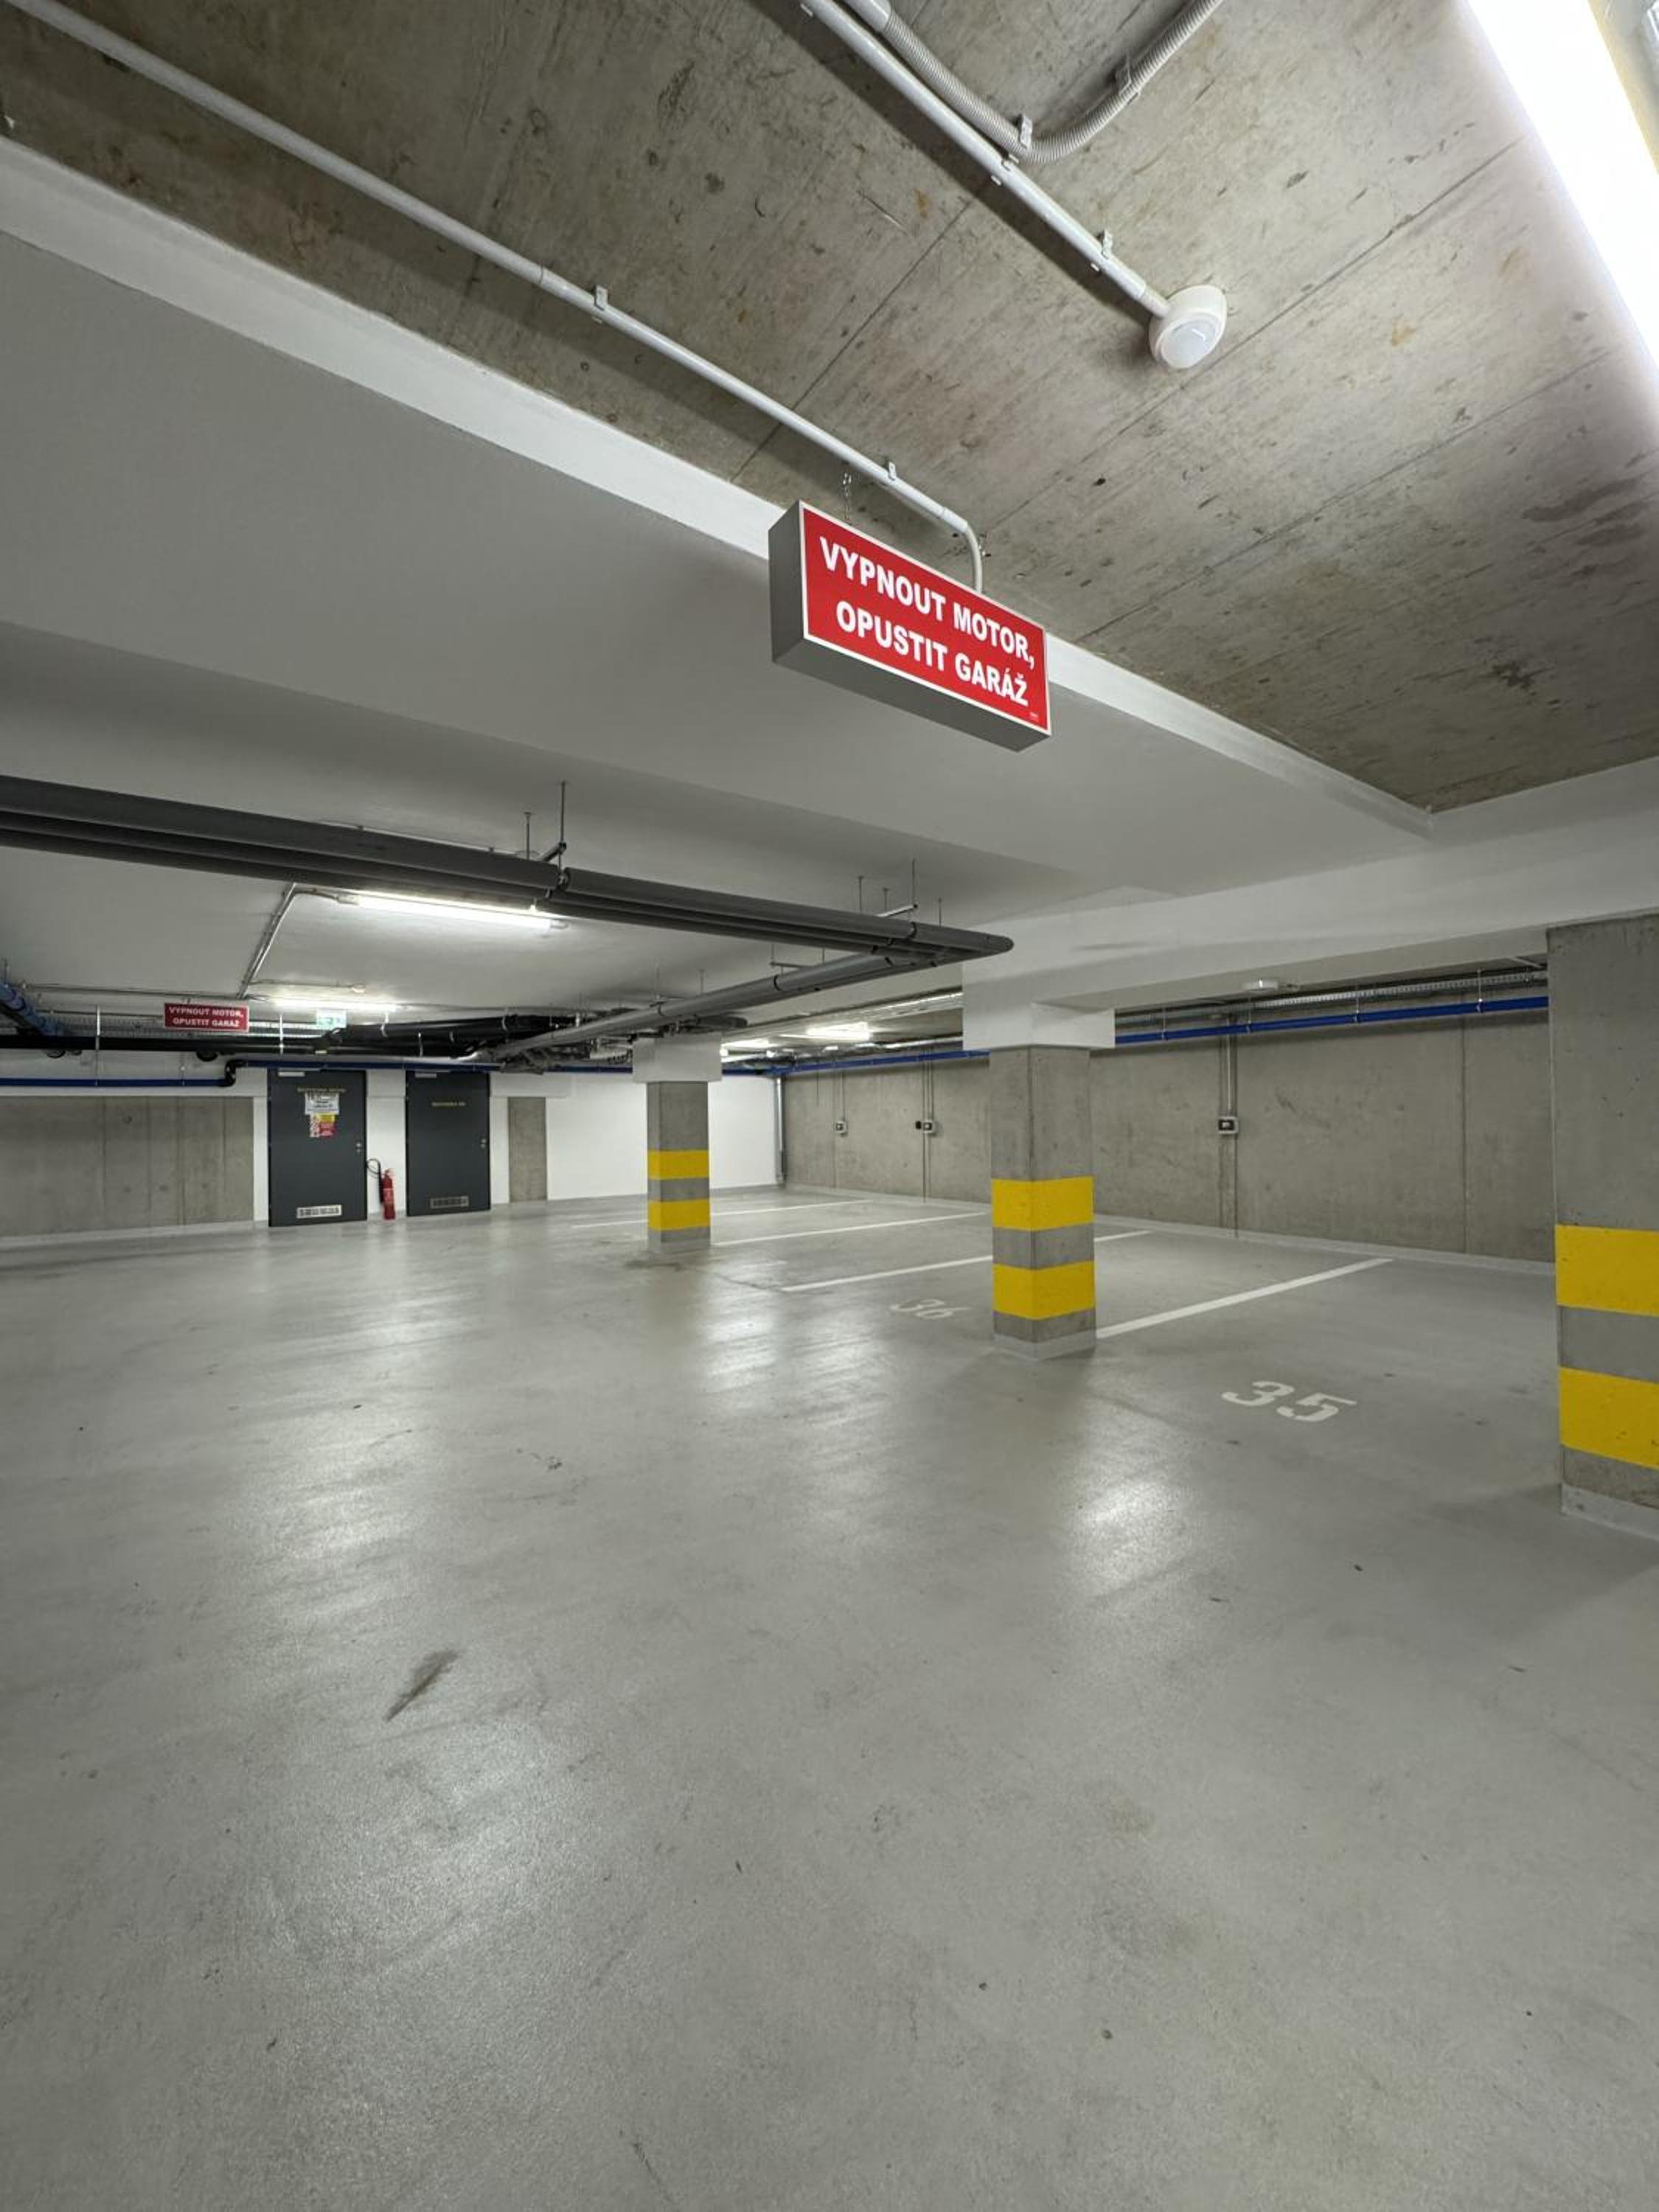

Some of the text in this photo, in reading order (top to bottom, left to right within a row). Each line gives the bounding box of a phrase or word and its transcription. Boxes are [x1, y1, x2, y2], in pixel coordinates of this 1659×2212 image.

[819, 536, 1035, 669] VYPNOUT MOTOR,
[836, 601, 1029, 706] OPUSTIT GARÁŽ
[169, 1006, 210, 1015] VYPNOUT
[173, 1018, 209, 1026] OPUSTIT
[889, 1298, 971, 1319] 36
[1221, 1380, 1357, 1422] 35
